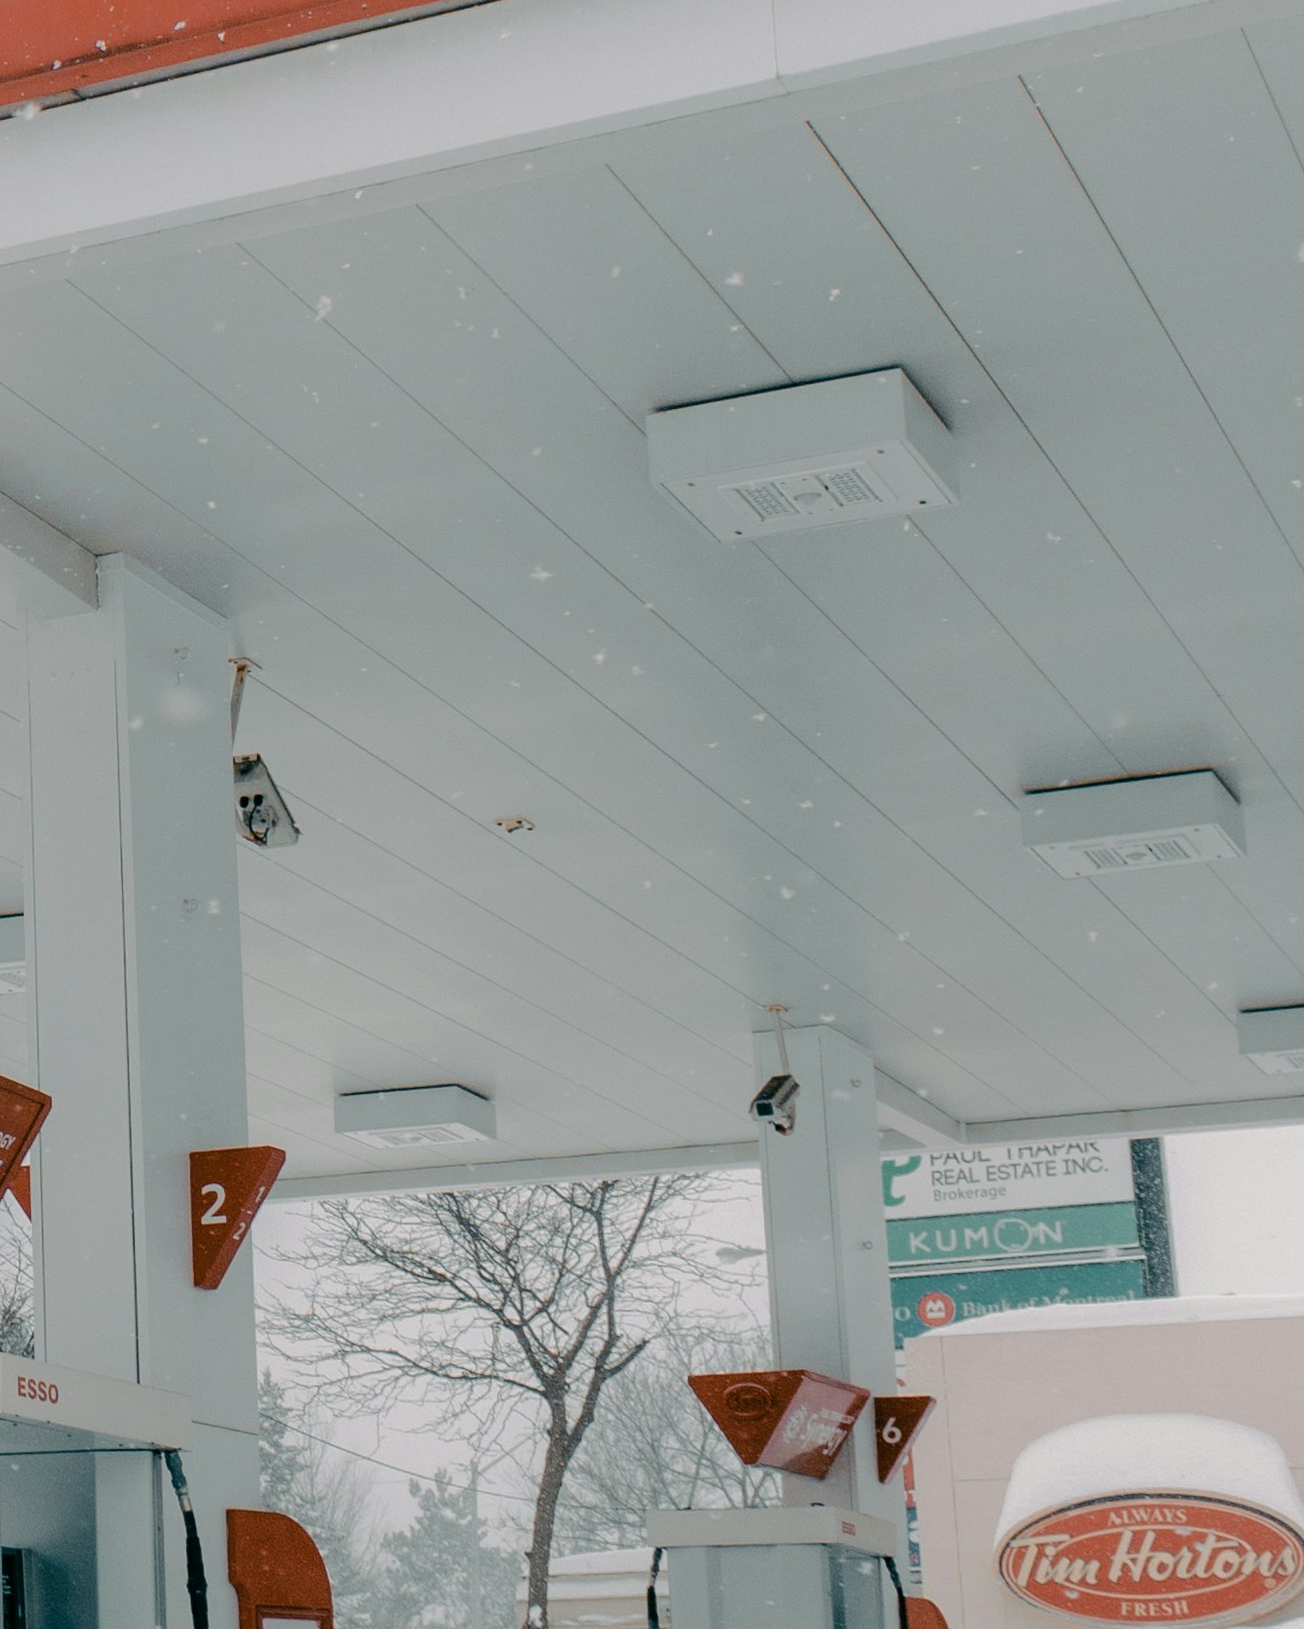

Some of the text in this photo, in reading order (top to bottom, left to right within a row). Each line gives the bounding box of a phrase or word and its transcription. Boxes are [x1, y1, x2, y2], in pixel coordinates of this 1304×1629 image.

[931, 1156, 1109, 1187] REAL ESTATE INC.
[200, 1183, 227, 1225] 2
[933, 1186, 1007, 1202] Brokerage
[908, 1218, 1064, 1254] KUMON
[17, 1375, 59, 1405] ESSO
[881, 1417, 902, 1444] 6
[1106, 1508, 1188, 1527] ALWAYS
[1009, 1527, 1296, 1588] Tim Hortons
[1120, 1600, 1190, 1618] FRESH
